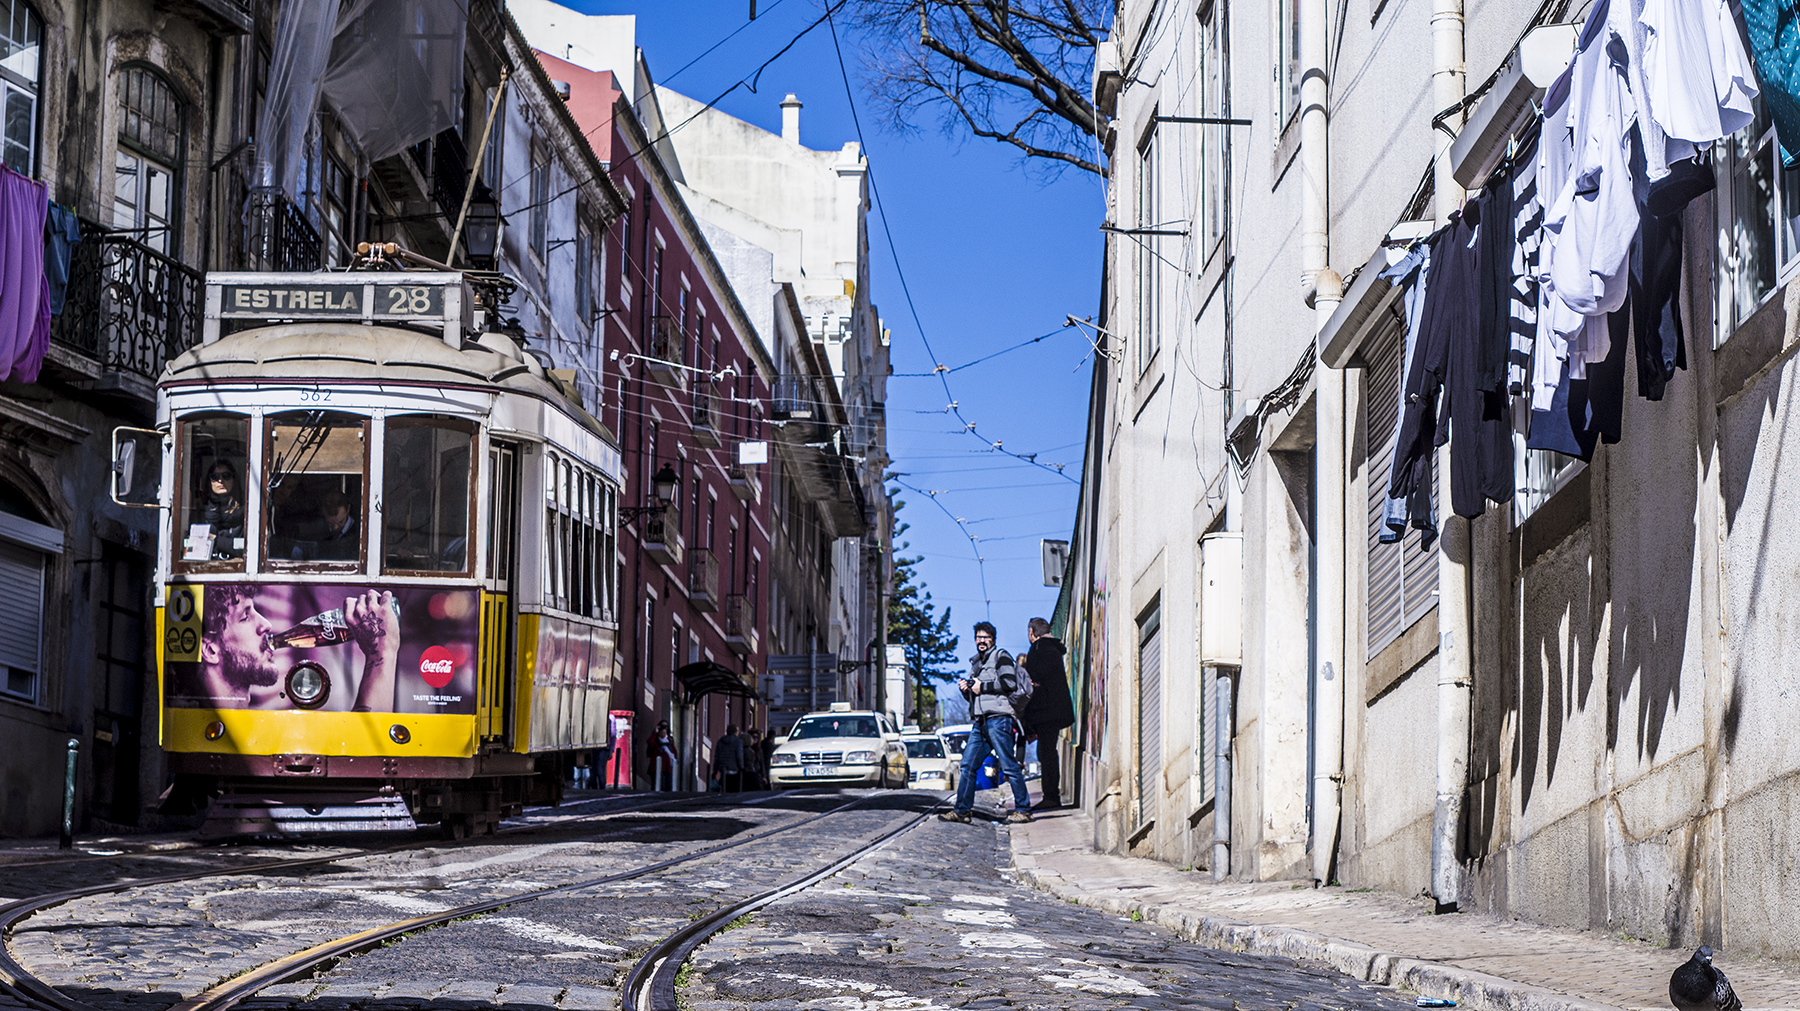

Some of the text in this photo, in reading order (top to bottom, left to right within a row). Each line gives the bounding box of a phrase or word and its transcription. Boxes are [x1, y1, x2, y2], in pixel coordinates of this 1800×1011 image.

[235, 286, 431, 313] ESTRELA 28
[300, 388, 332, 402] 562
[430, 694, 440, 702] THE
